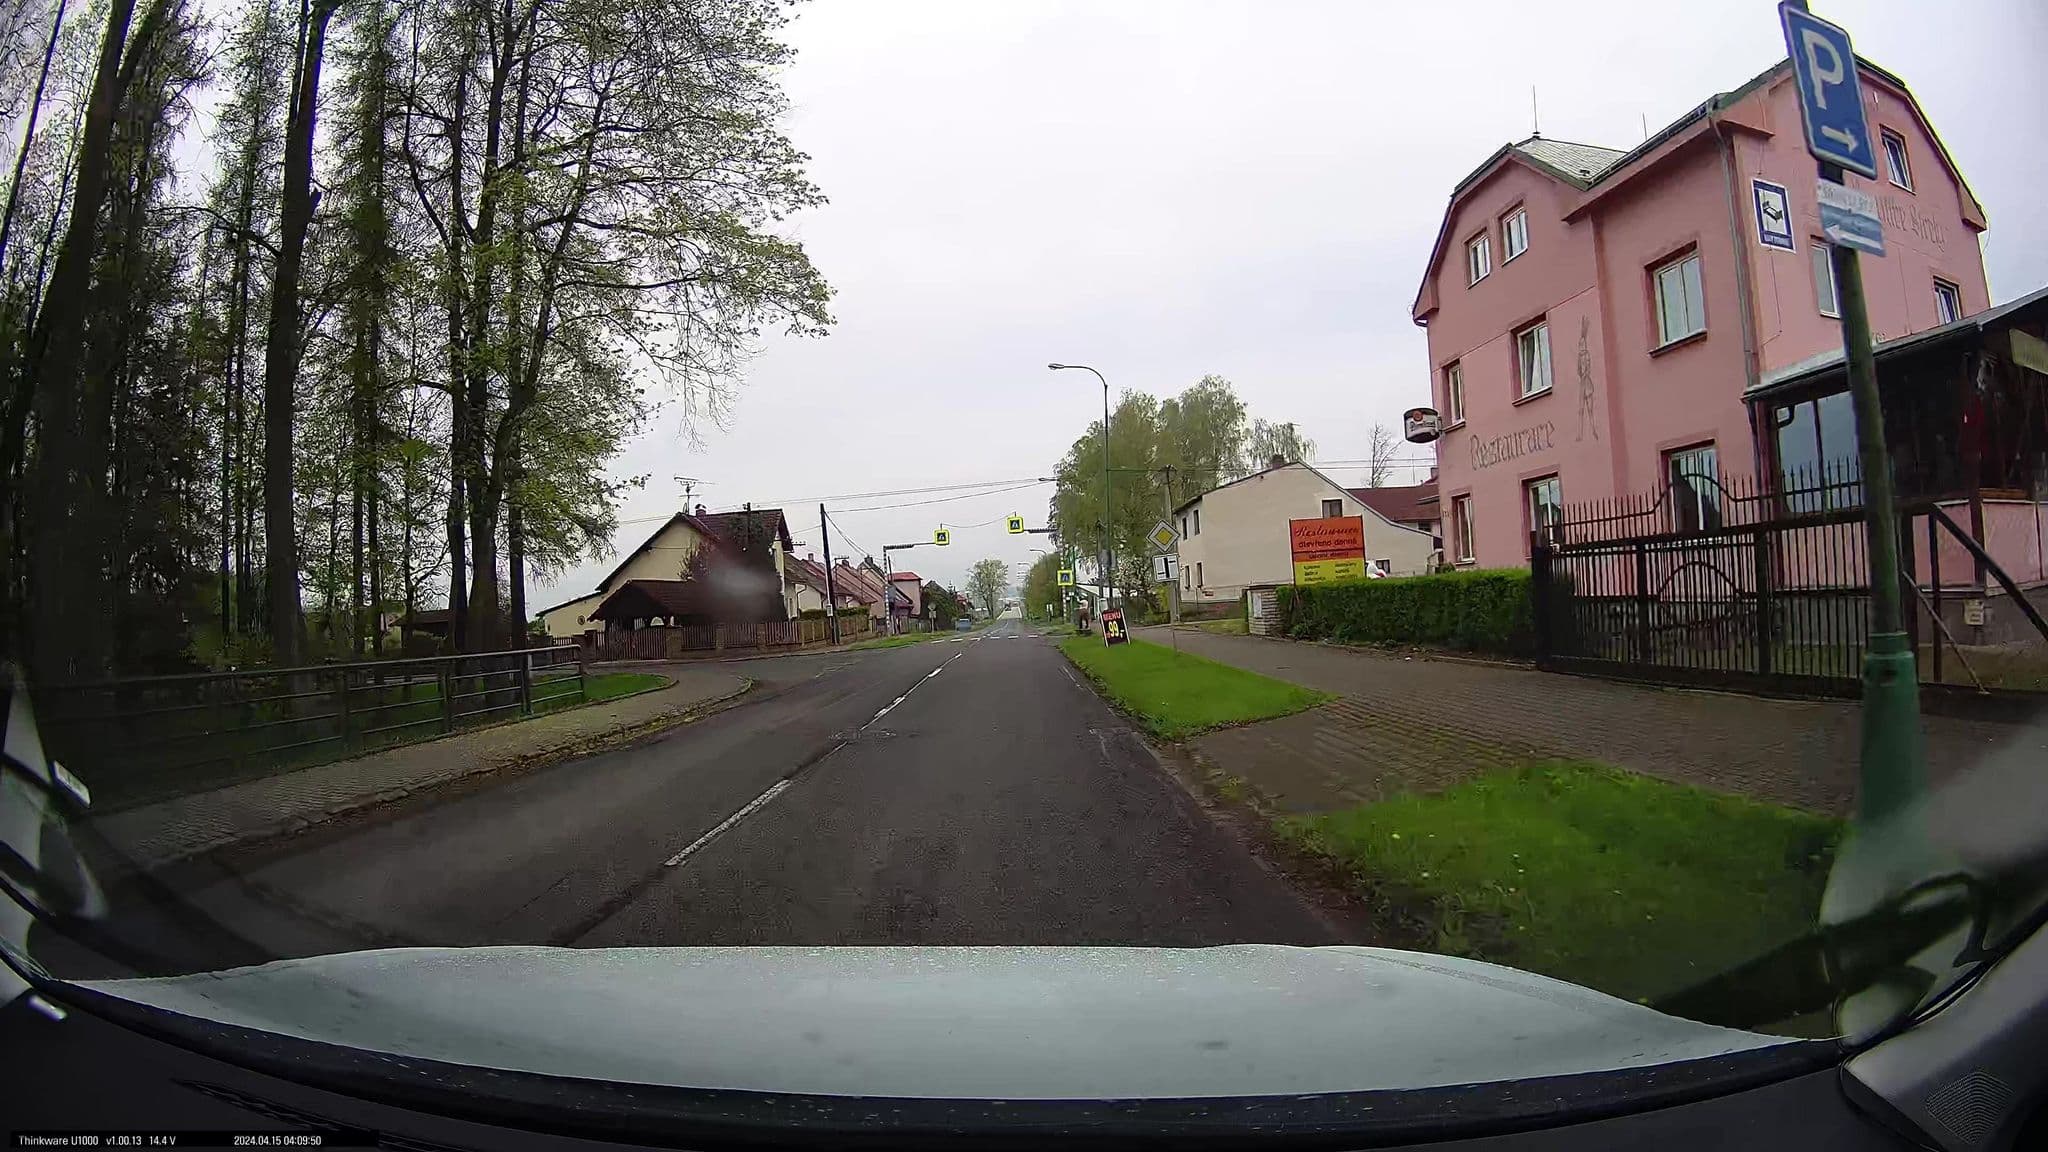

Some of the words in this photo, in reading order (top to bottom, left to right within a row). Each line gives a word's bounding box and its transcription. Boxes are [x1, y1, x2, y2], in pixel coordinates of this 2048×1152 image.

[1800, 28, 1844, 110] P
[1469, 420, 1556, 472] Restaurace
[1103, 610, 1121, 620] MENU
